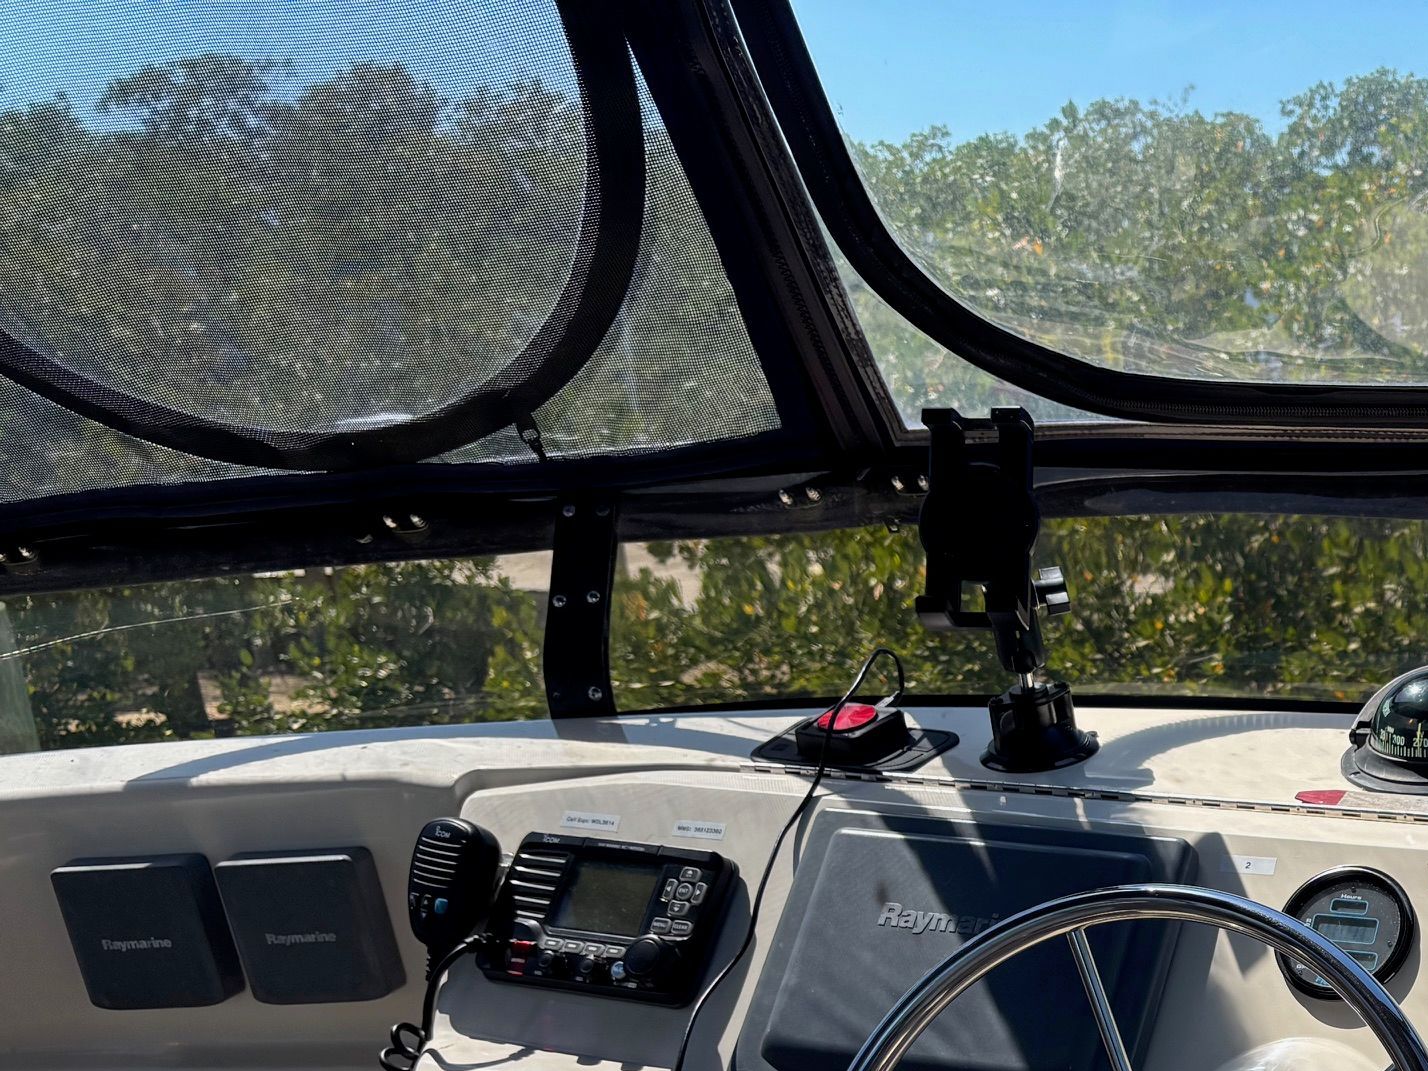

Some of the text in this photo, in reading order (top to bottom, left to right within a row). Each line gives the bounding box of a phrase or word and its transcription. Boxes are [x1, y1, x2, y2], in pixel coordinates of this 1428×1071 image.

[1392, 734, 1405, 746] 300
[1413, 737, 1428, 748] 270
[1245, 861, 1251, 869] 2
[877, 902, 1000, 935] Raymari
[101, 937, 173, 952] Raymarine
[264, 930, 337, 946] Raymarine
